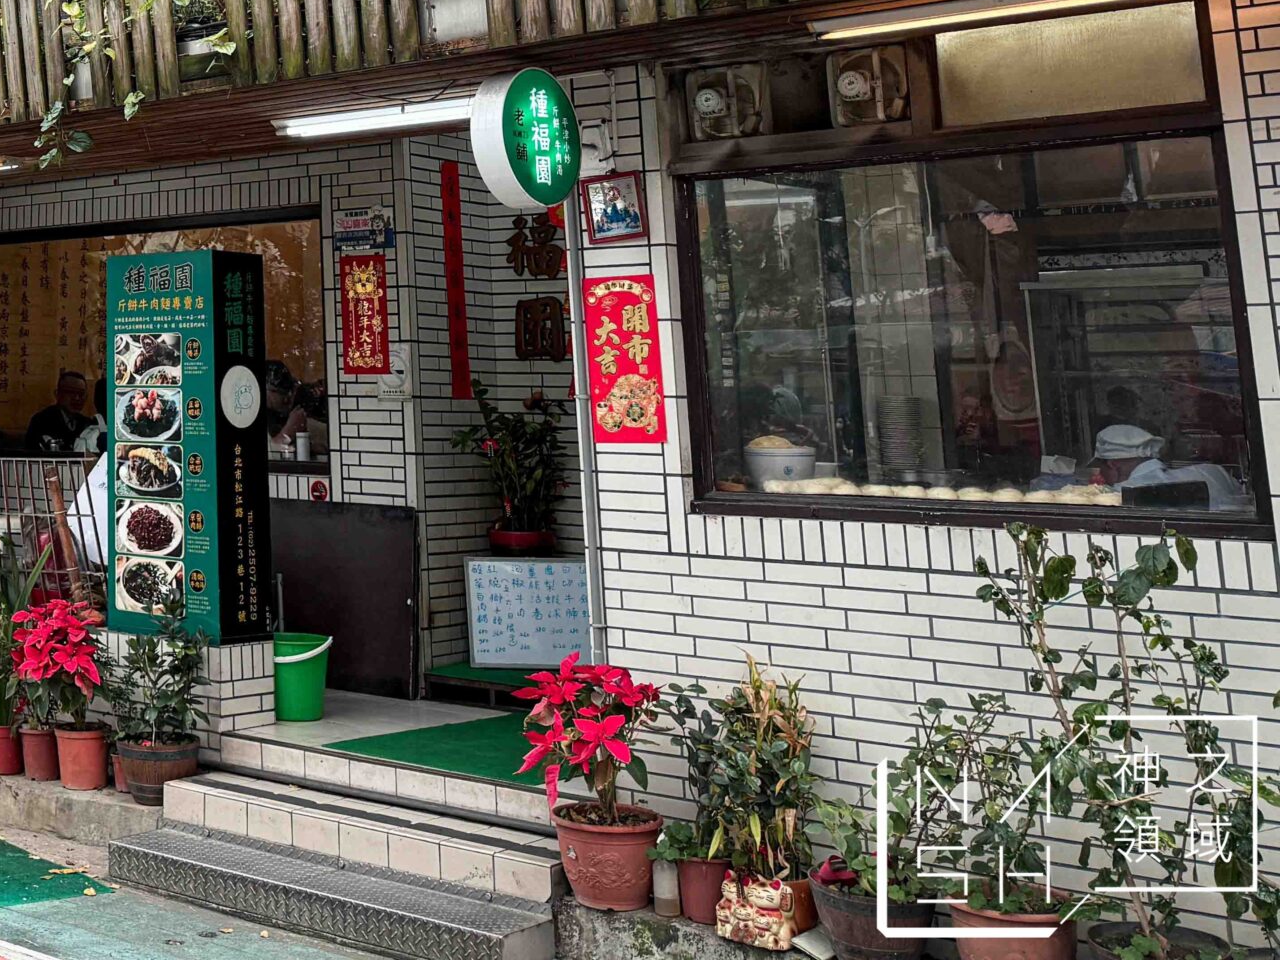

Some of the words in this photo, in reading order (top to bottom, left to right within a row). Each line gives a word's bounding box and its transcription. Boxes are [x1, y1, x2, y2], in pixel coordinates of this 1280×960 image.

[529, 87, 552, 186] 種福園
[123, 262, 194, 295] 種福園
[224, 271, 244, 356] 種福園
[622, 303, 653, 365] 開市
[593, 315, 621, 375] 大吉
